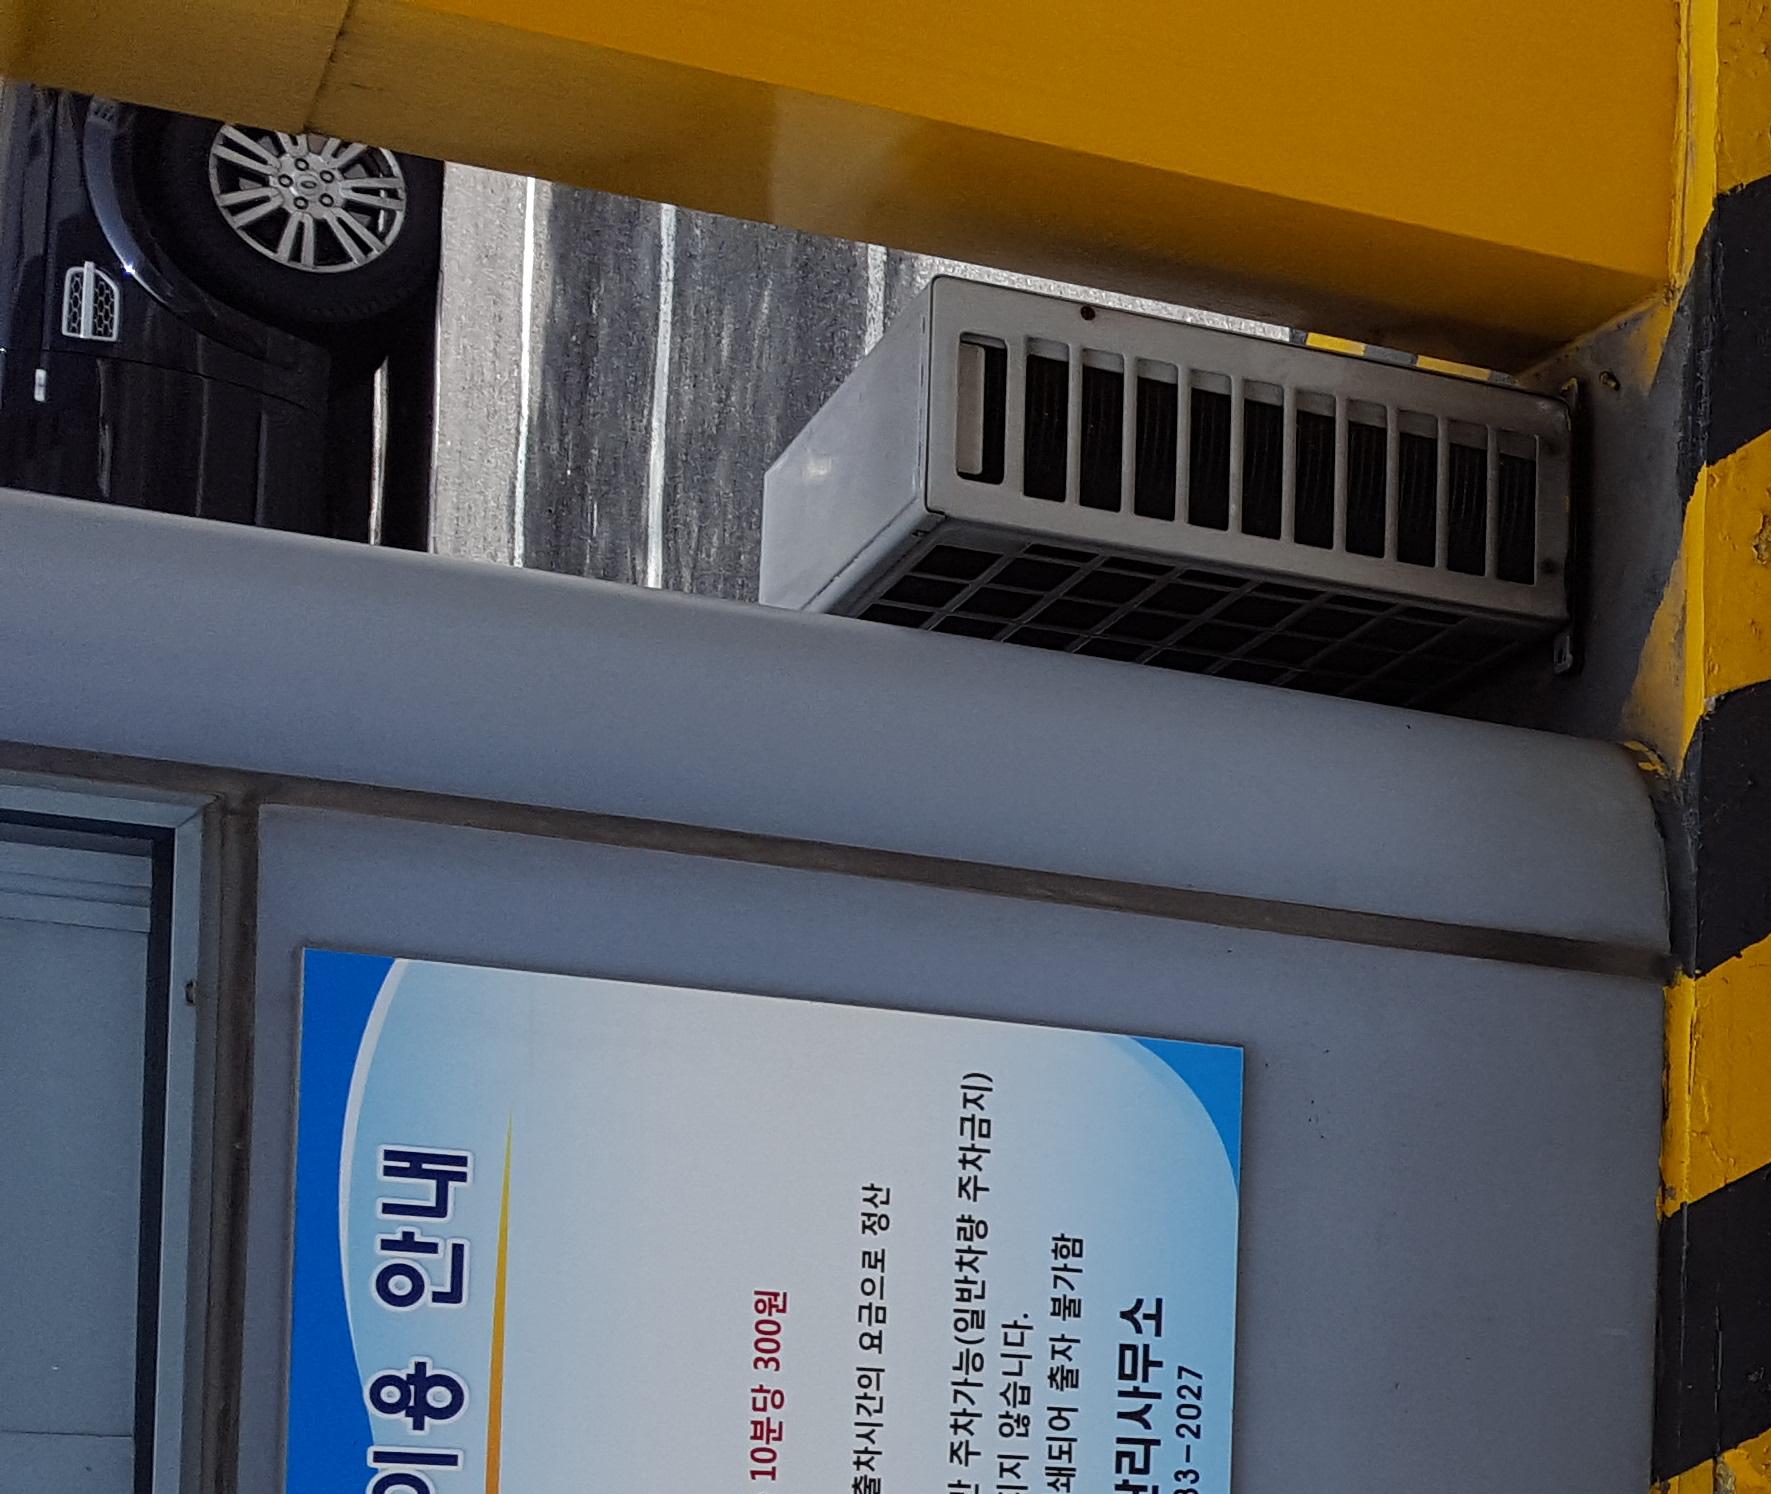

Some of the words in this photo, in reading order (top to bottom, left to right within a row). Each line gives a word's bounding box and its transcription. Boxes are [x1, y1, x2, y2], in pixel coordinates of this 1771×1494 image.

[958, 1073, 993, 1202] 주차금지)
[369, 1142, 474, 1314] 안내
[861, 1183, 890, 1236] 정산
[858, 1249, 886, 1354] 요금으로
[1050, 1233, 1083, 1321] 불가함
[753, 1291, 787, 1371] 300원
[998, 1313, 1034, 1438] 않습니다.
[1047, 1334, 1080, 1391] 출자
[750, 1384, 784, 1481] 10분당
